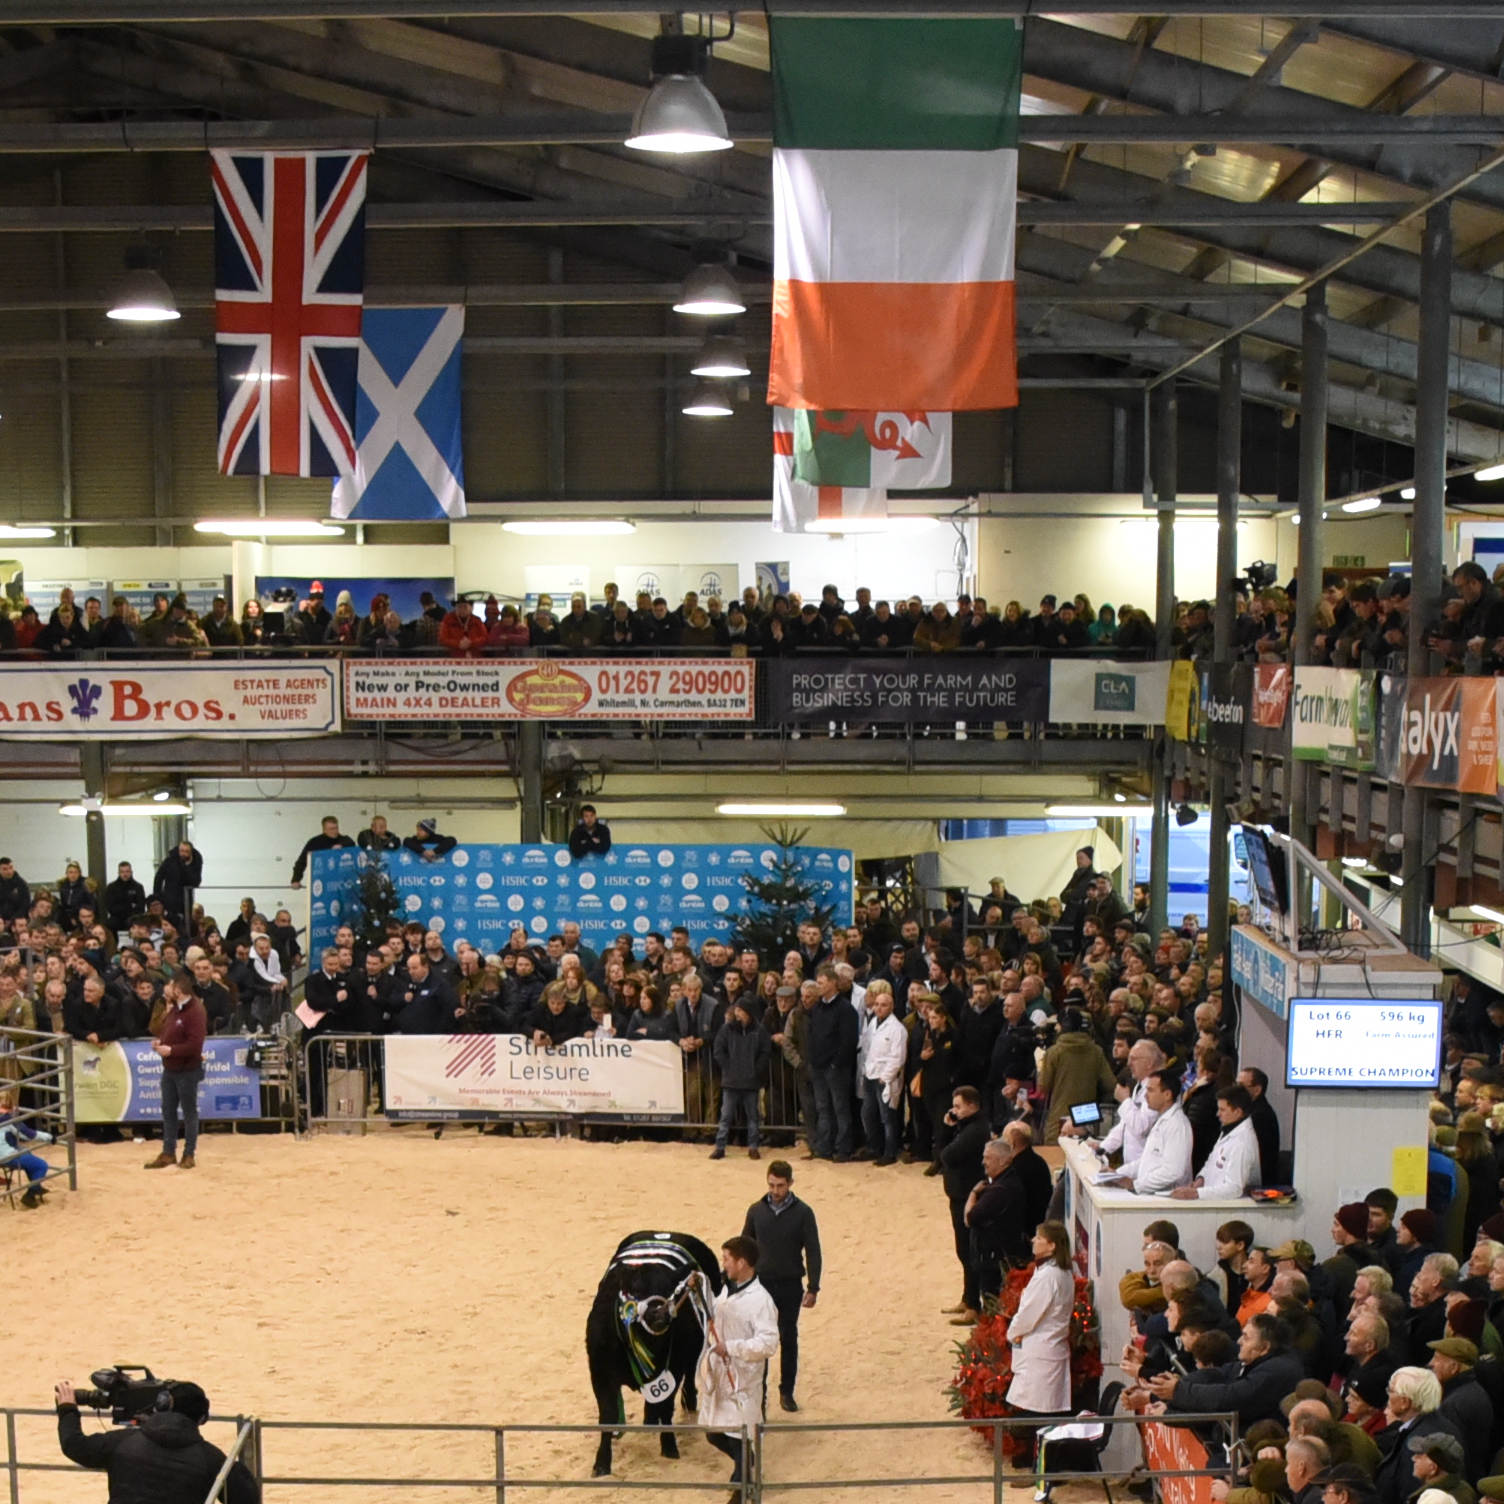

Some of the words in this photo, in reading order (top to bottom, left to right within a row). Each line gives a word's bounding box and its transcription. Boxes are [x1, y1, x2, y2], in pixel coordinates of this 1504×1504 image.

[354, 669, 370, 679] Any
[373, 669, 396, 677] Make
[404, 669, 420, 679] Any
[423, 669, 449, 677] Model
[234, 679, 280, 690] ESTATE
[284, 679, 328, 690] AGENTS
[355, 680, 388, 692] New
[394, 682, 410, 692] or
[415, 680, 500, 692] Pre-Owned
[598, 669, 661, 695] 01267
[669, 669, 746, 695] 290900
[793, 674, 867, 689] PROTECT
[872, 674, 918, 689] YOUR
[923, 674, 972, 689] FARM
[978, 674, 1017, 689] AND
[1101, 680, 1129, 694] CLA
[110, 680, 236, 722] Bros.
[242, 693, 317, 706] AUCTIONEERS
[355, 697, 397, 708] MAIN
[403, 697, 433, 708] 4X4
[438, 697, 501, 708] DEALER
[640, 698, 652, 708] Nr.
[707, 698, 728, 709] SA32
[729, 698, 746, 708] 7EN
[793, 692, 872, 707] BUSINESS
[878, 692, 912, 707] FOR
[917, 692, 949, 707] THE
[955, 692, 1017, 707] FUTURE
[259, 708, 308, 721] VALUERS
[398, 875, 428, 887] HSBC
[501, 875, 530, 887] HSBC
[604, 875, 632, 887] HSBC
[706, 875, 735, 887] HSBC
[477, 919, 507, 930] HSBC
[580, 919, 608, 930] HSBC
[682, 919, 711, 930] HSBC
[1309, 1010, 1330, 1021] Lot
[1336, 1010, 1352, 1021] 66
[1380, 1011, 1404, 1022] 596
[1409, 1011, 1425, 1025] kg
[1316, 1029, 1343, 1039] HFR
[1366, 1031, 1391, 1039] Farm
[1394, 1031, 1435, 1040] Assured
[508, 1036, 633, 1058] Streamline
[509, 1060, 590, 1082] Leisure
[1291, 1067, 1354, 1078] SUPREME
[1359, 1067, 1435, 1078] CHAMPION
[100, 1080, 119, 1090] DGC
[204, 1076, 250, 1086] sponsible
[458, 1087, 501, 1096] Memorable
[502, 1087, 526, 1097] Events
[527, 1088, 541, 1097] Are
[542, 1088, 569, 1099] Always
[649, 1378, 670, 1399] 66
